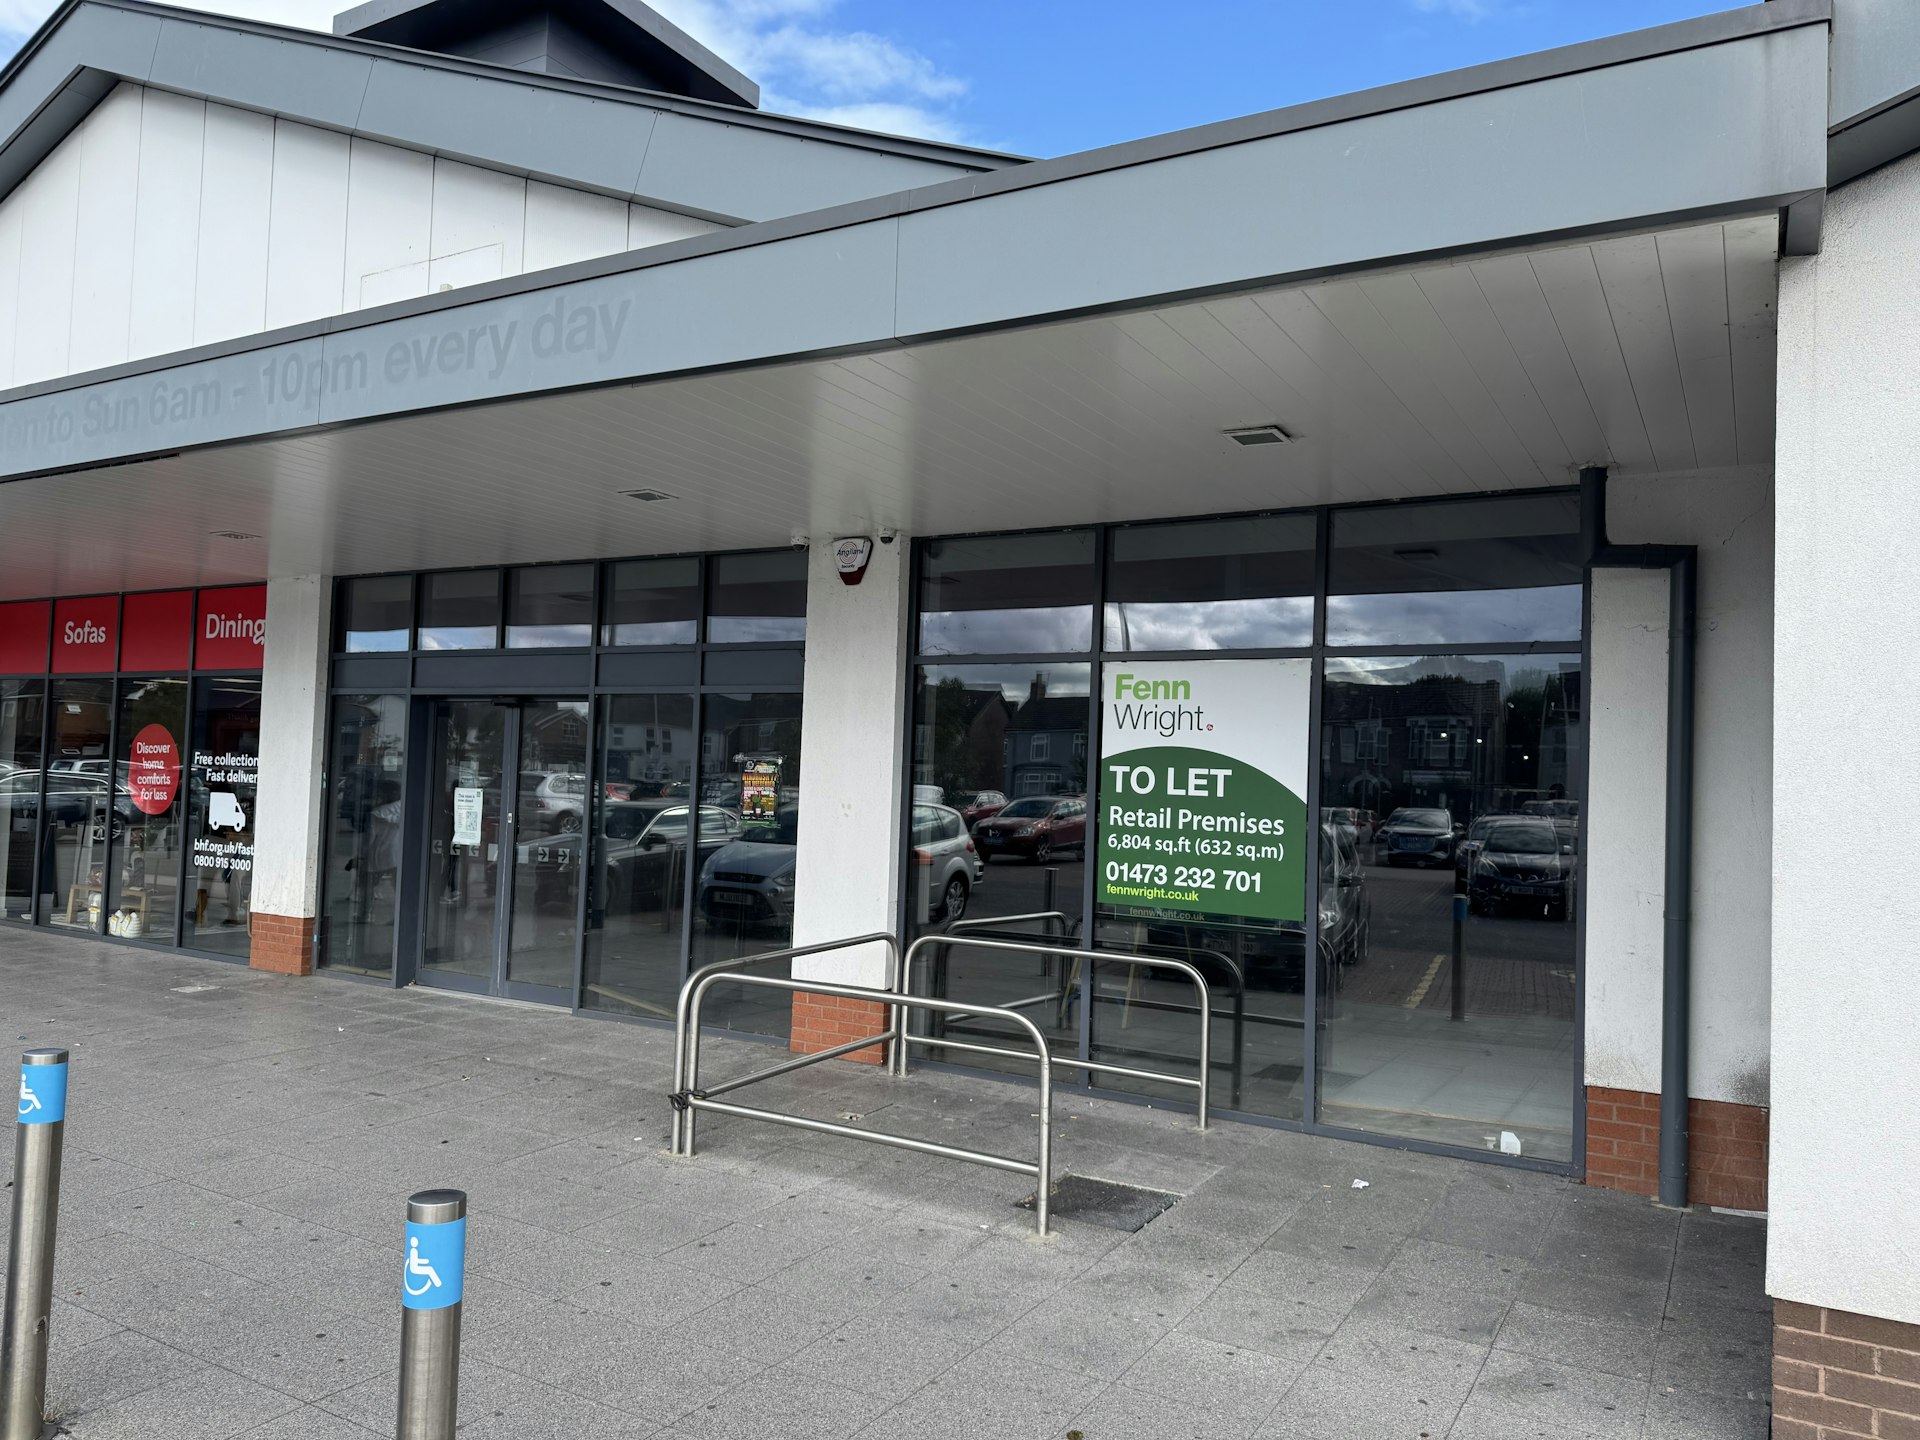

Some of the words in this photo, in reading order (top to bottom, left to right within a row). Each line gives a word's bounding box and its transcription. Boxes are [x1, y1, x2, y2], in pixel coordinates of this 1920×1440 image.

[47, 404, 74, 443] to
[82, 393, 140, 438] Sun
[150, 380, 222, 426] 6am
[262, 346, 368, 410] 10pm
[383, 320, 518, 384] every
[531, 297, 632, 363] day
[64, 620, 107, 645] Sofas
[205, 613, 267, 646] Dining
[1115, 673, 1191, 701] Fenn
[136, 742, 171, 754] Discover
[142, 757, 165, 770] home
[194, 751, 213, 766] Free
[215, 752, 260, 768] collection
[137, 772, 171, 785] comforts
[206, 768, 226, 782] Fast
[226, 770, 258, 784] deliver
[1109, 765, 1156, 795] TO
[1166, 767, 1233, 798] LET
[140, 788, 154, 800] for
[154, 788, 168, 801] less
[1109, 805, 1172, 830] Retail
[1178, 808, 1285, 836] Premises
[194, 838, 256, 856] bhf.org.uk/fast
[1107, 833, 1152, 851] 6,804
[1154, 836, 1191, 856] sq.ft
[1195, 837, 1232, 856] (632
[1235, 842, 1285, 862] sq.m)
[194, 855, 214, 867] 0800
[215, 857, 229, 869] 915
[230, 858, 252, 872] 3000
[1105, 861, 1168, 886] 01473
[1174, 866, 1216, 890] 232
[1222, 869, 1262, 893] 701
[1106, 883, 1200, 902] fennwright.co.uk
